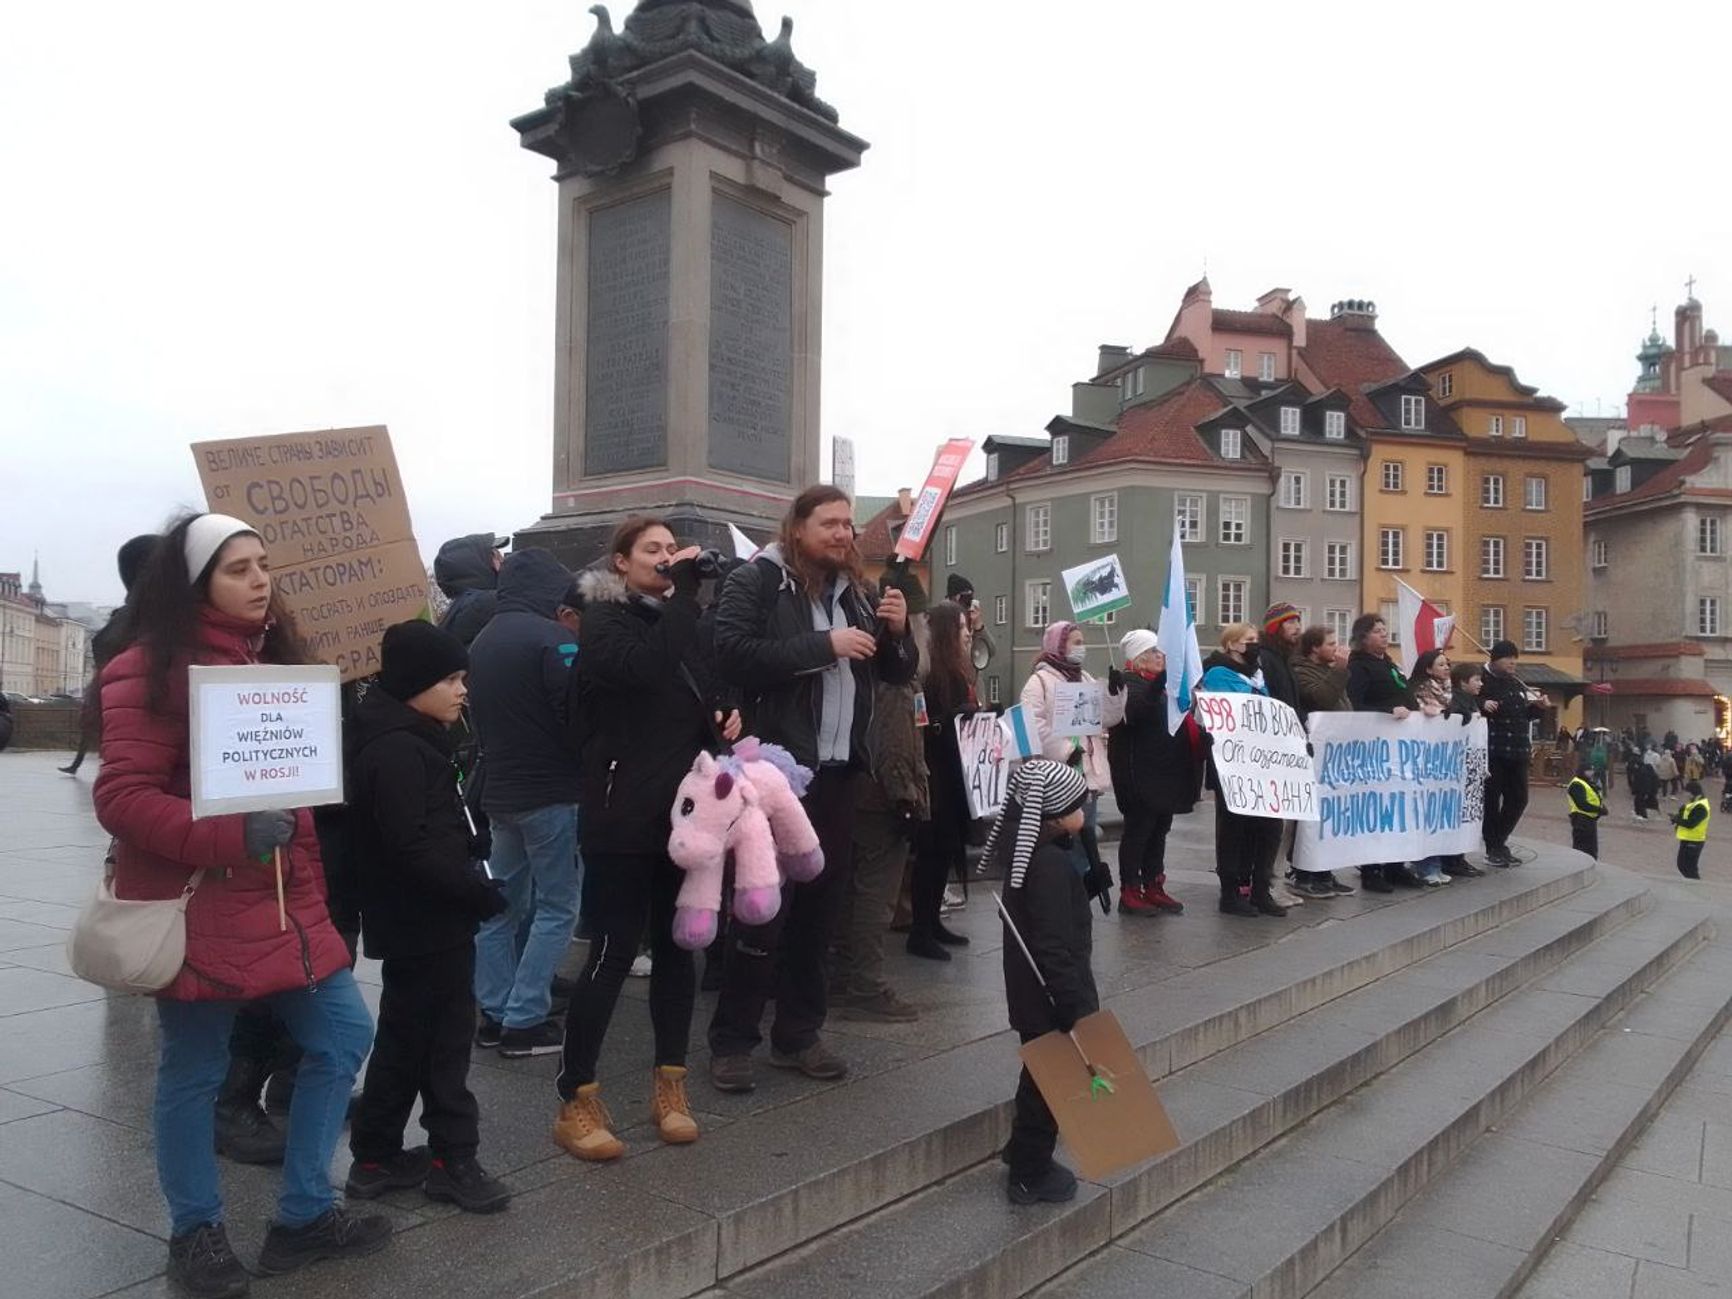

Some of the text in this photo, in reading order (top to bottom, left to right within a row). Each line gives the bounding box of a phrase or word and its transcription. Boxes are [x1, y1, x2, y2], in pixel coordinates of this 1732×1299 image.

[270, 442, 313, 464] СТРАНЫ
[316, 436, 373, 460] ЗАВИСИТ
[246, 468, 392, 515] СВОБОДЫ
[262, 511, 369, 545] ОГАТСТВА
[302, 530, 380, 557] НАРОДА
[273, 557, 383, 596] КТАТОРАМ:
[368, 584, 424, 607] ОПОЗДАТЬ
[331, 642, 383, 674] СРА
[237, 688, 308, 705] WOLNOŚĆ
[261, 712, 283, 723] DLA
[1198, 697, 1236, 732] 998
[1241, 699, 1268, 733] ДЕНЬ
[237, 726, 304, 745] WIĘŹNIÓW
[223, 746, 317, 763] POLITYCZNYCH
[244, 768, 257, 780] W
[1269, 780, 1280, 813] 3
